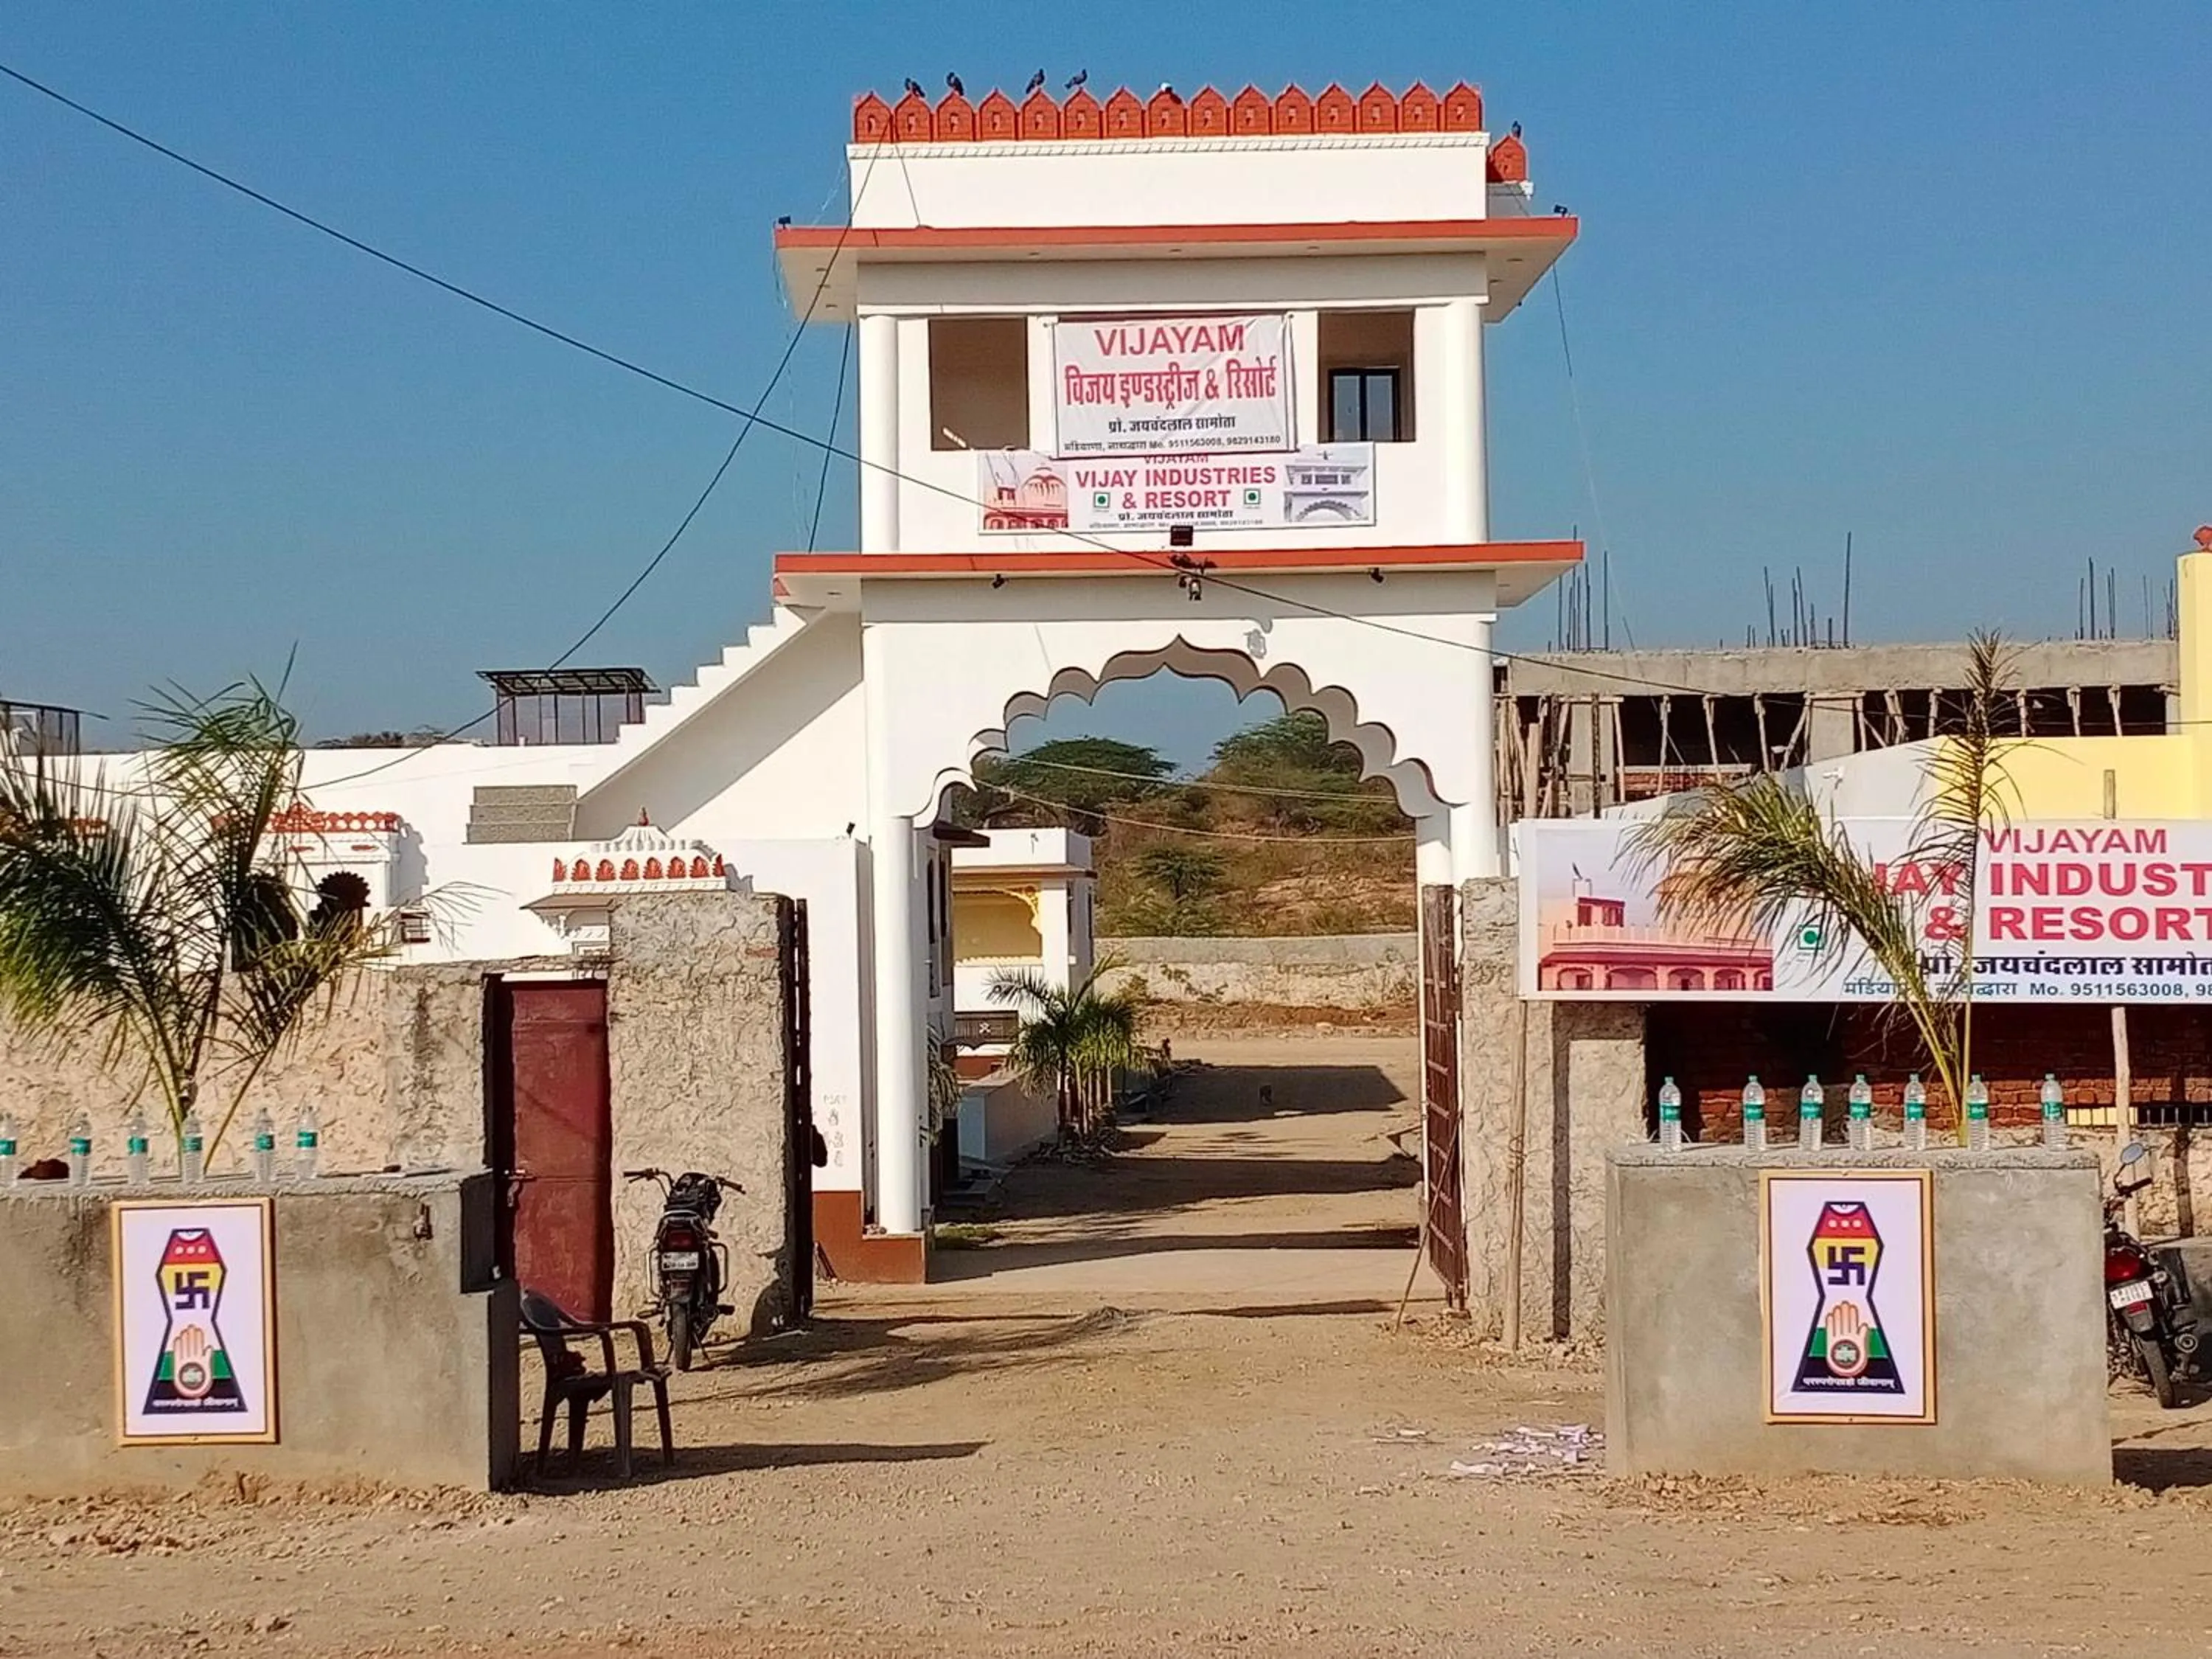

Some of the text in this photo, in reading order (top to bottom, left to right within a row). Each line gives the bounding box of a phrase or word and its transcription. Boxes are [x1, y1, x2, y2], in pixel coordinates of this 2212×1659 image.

[1094, 324, 1245, 356] VIJAYAM
[1065, 365, 1116, 405] विजय
[1205, 368, 1220, 400] &
[1225, 355, 1276, 399] रिसोर्ट
[1076, 466, 1276, 488] VIJAY INDUSTRIES
[1122, 490, 1231, 509] & RESORT
[1983, 828, 2167, 854] VIJAYAM
[1990, 862, 2212, 897] INDUST
[1924, 905, 1969, 940] &
[1971, 950, 2127, 975] जयचंदलाल
[2029, 982, 2065, 996] Mo.
[2070, 982, 2189, 998] 9511563008,
